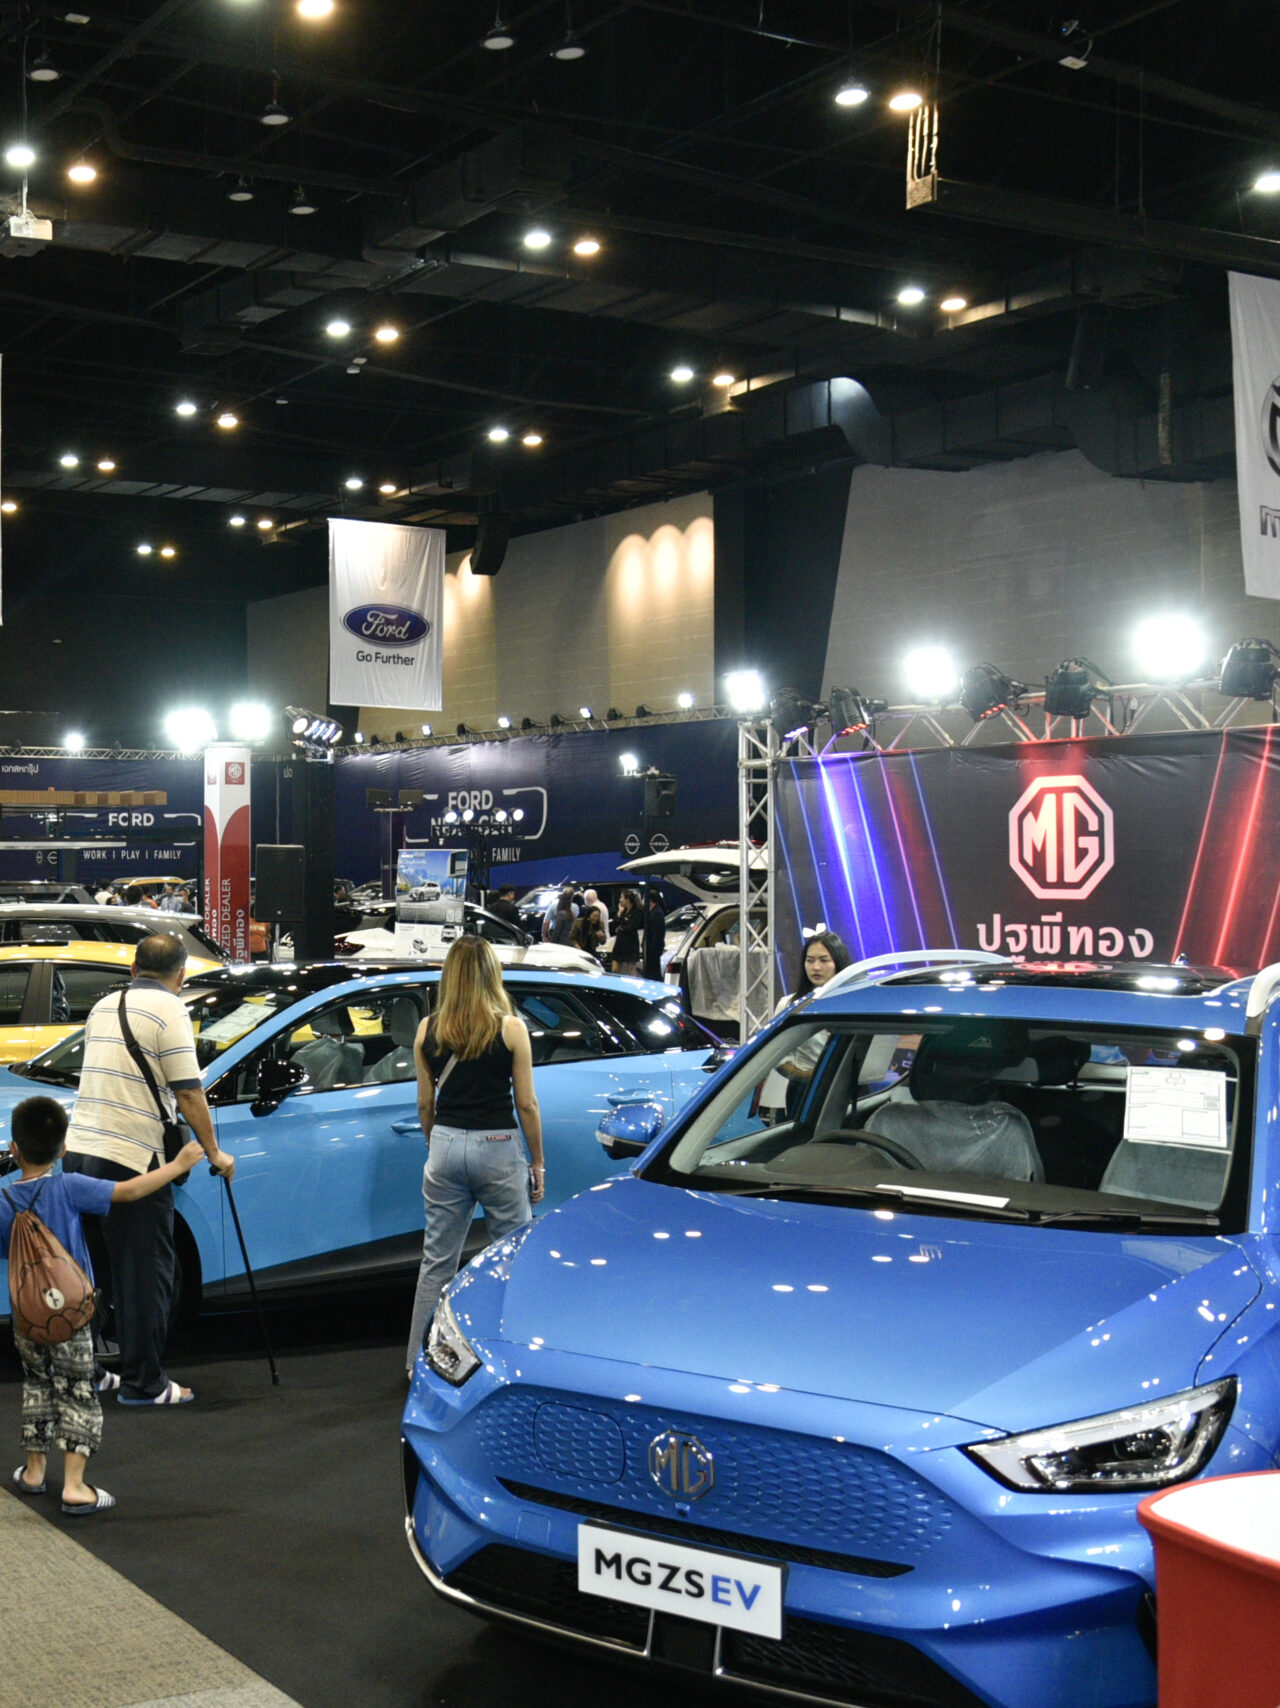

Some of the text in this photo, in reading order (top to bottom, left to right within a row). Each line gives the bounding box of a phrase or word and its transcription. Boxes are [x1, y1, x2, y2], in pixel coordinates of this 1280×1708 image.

[361, 610, 411, 639] Ford
[356, 650, 415, 666] Go Further
[448, 789, 493, 810] FORD
[1022, 792, 1101, 884] MG
[83, 850, 181, 860] WORK PLAY FAMILY
[492, 847, 520, 861] FAMILY
[222, 878, 231, 921] DEALER
[976, 911, 1154, 963] ปฐพีทอง
[655, 1436, 708, 1494] MG
